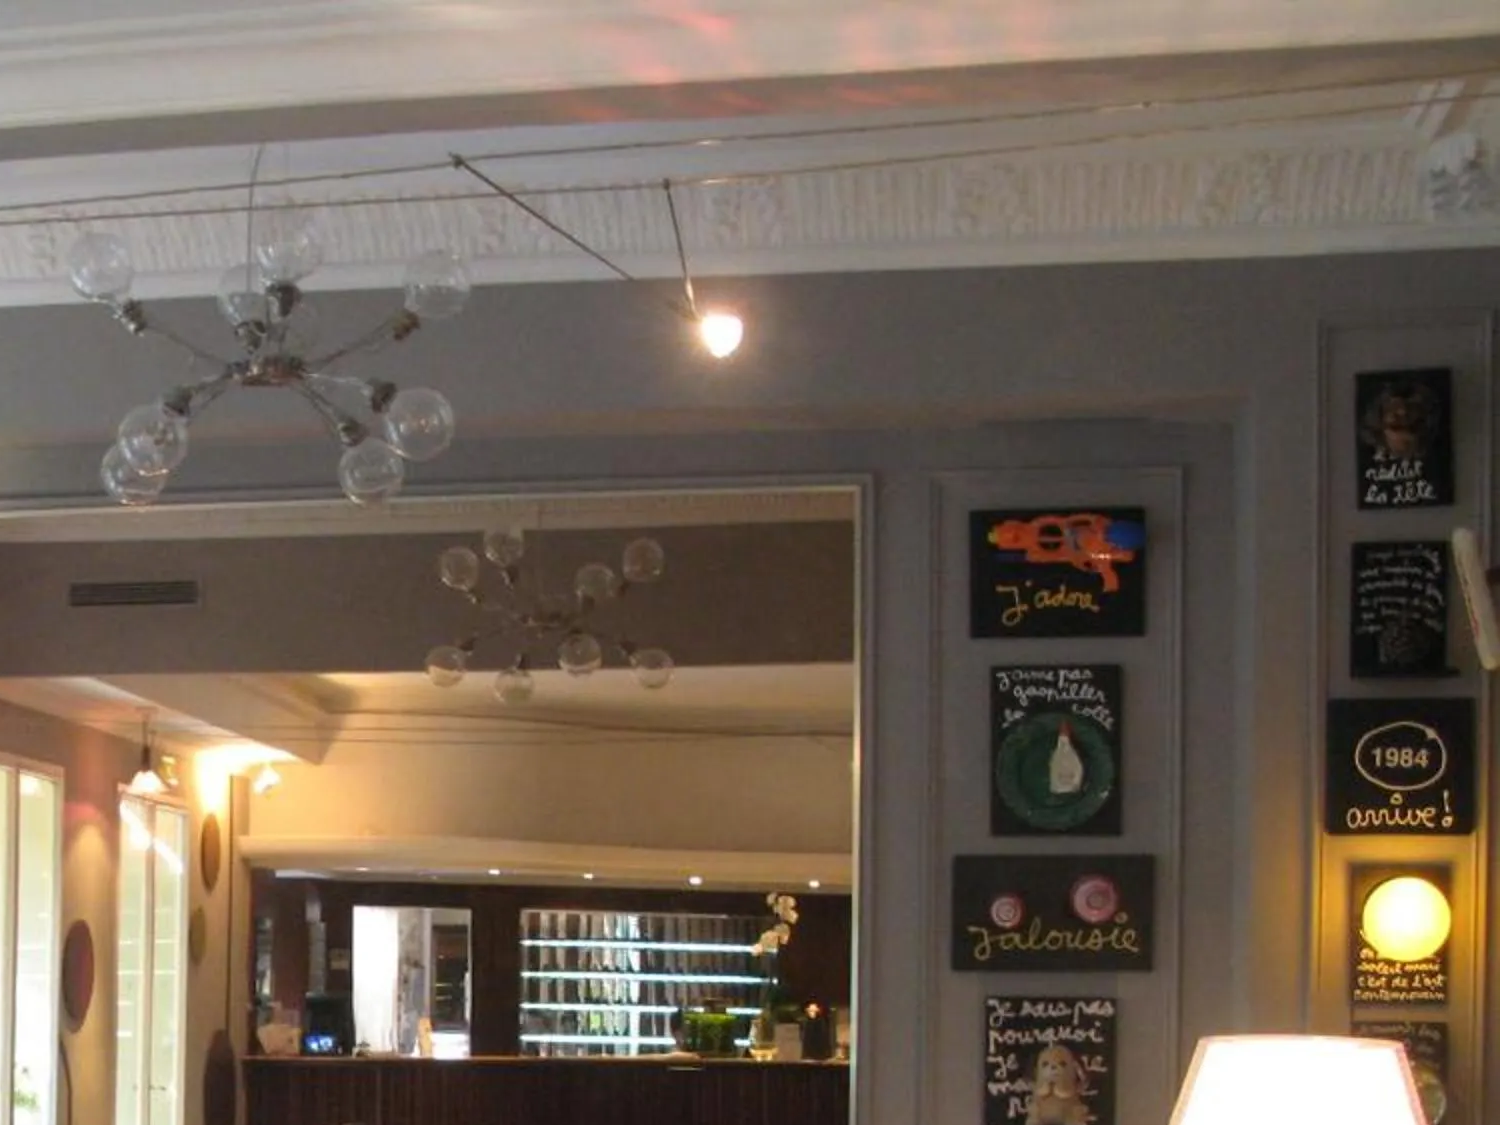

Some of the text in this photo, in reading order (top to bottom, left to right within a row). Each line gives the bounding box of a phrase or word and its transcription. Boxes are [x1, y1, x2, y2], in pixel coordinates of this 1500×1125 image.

[1057, 668, 1094, 690] pas
[1371, 746, 1429, 768] 1984
[989, 1020, 1105, 1054] pourquoi
